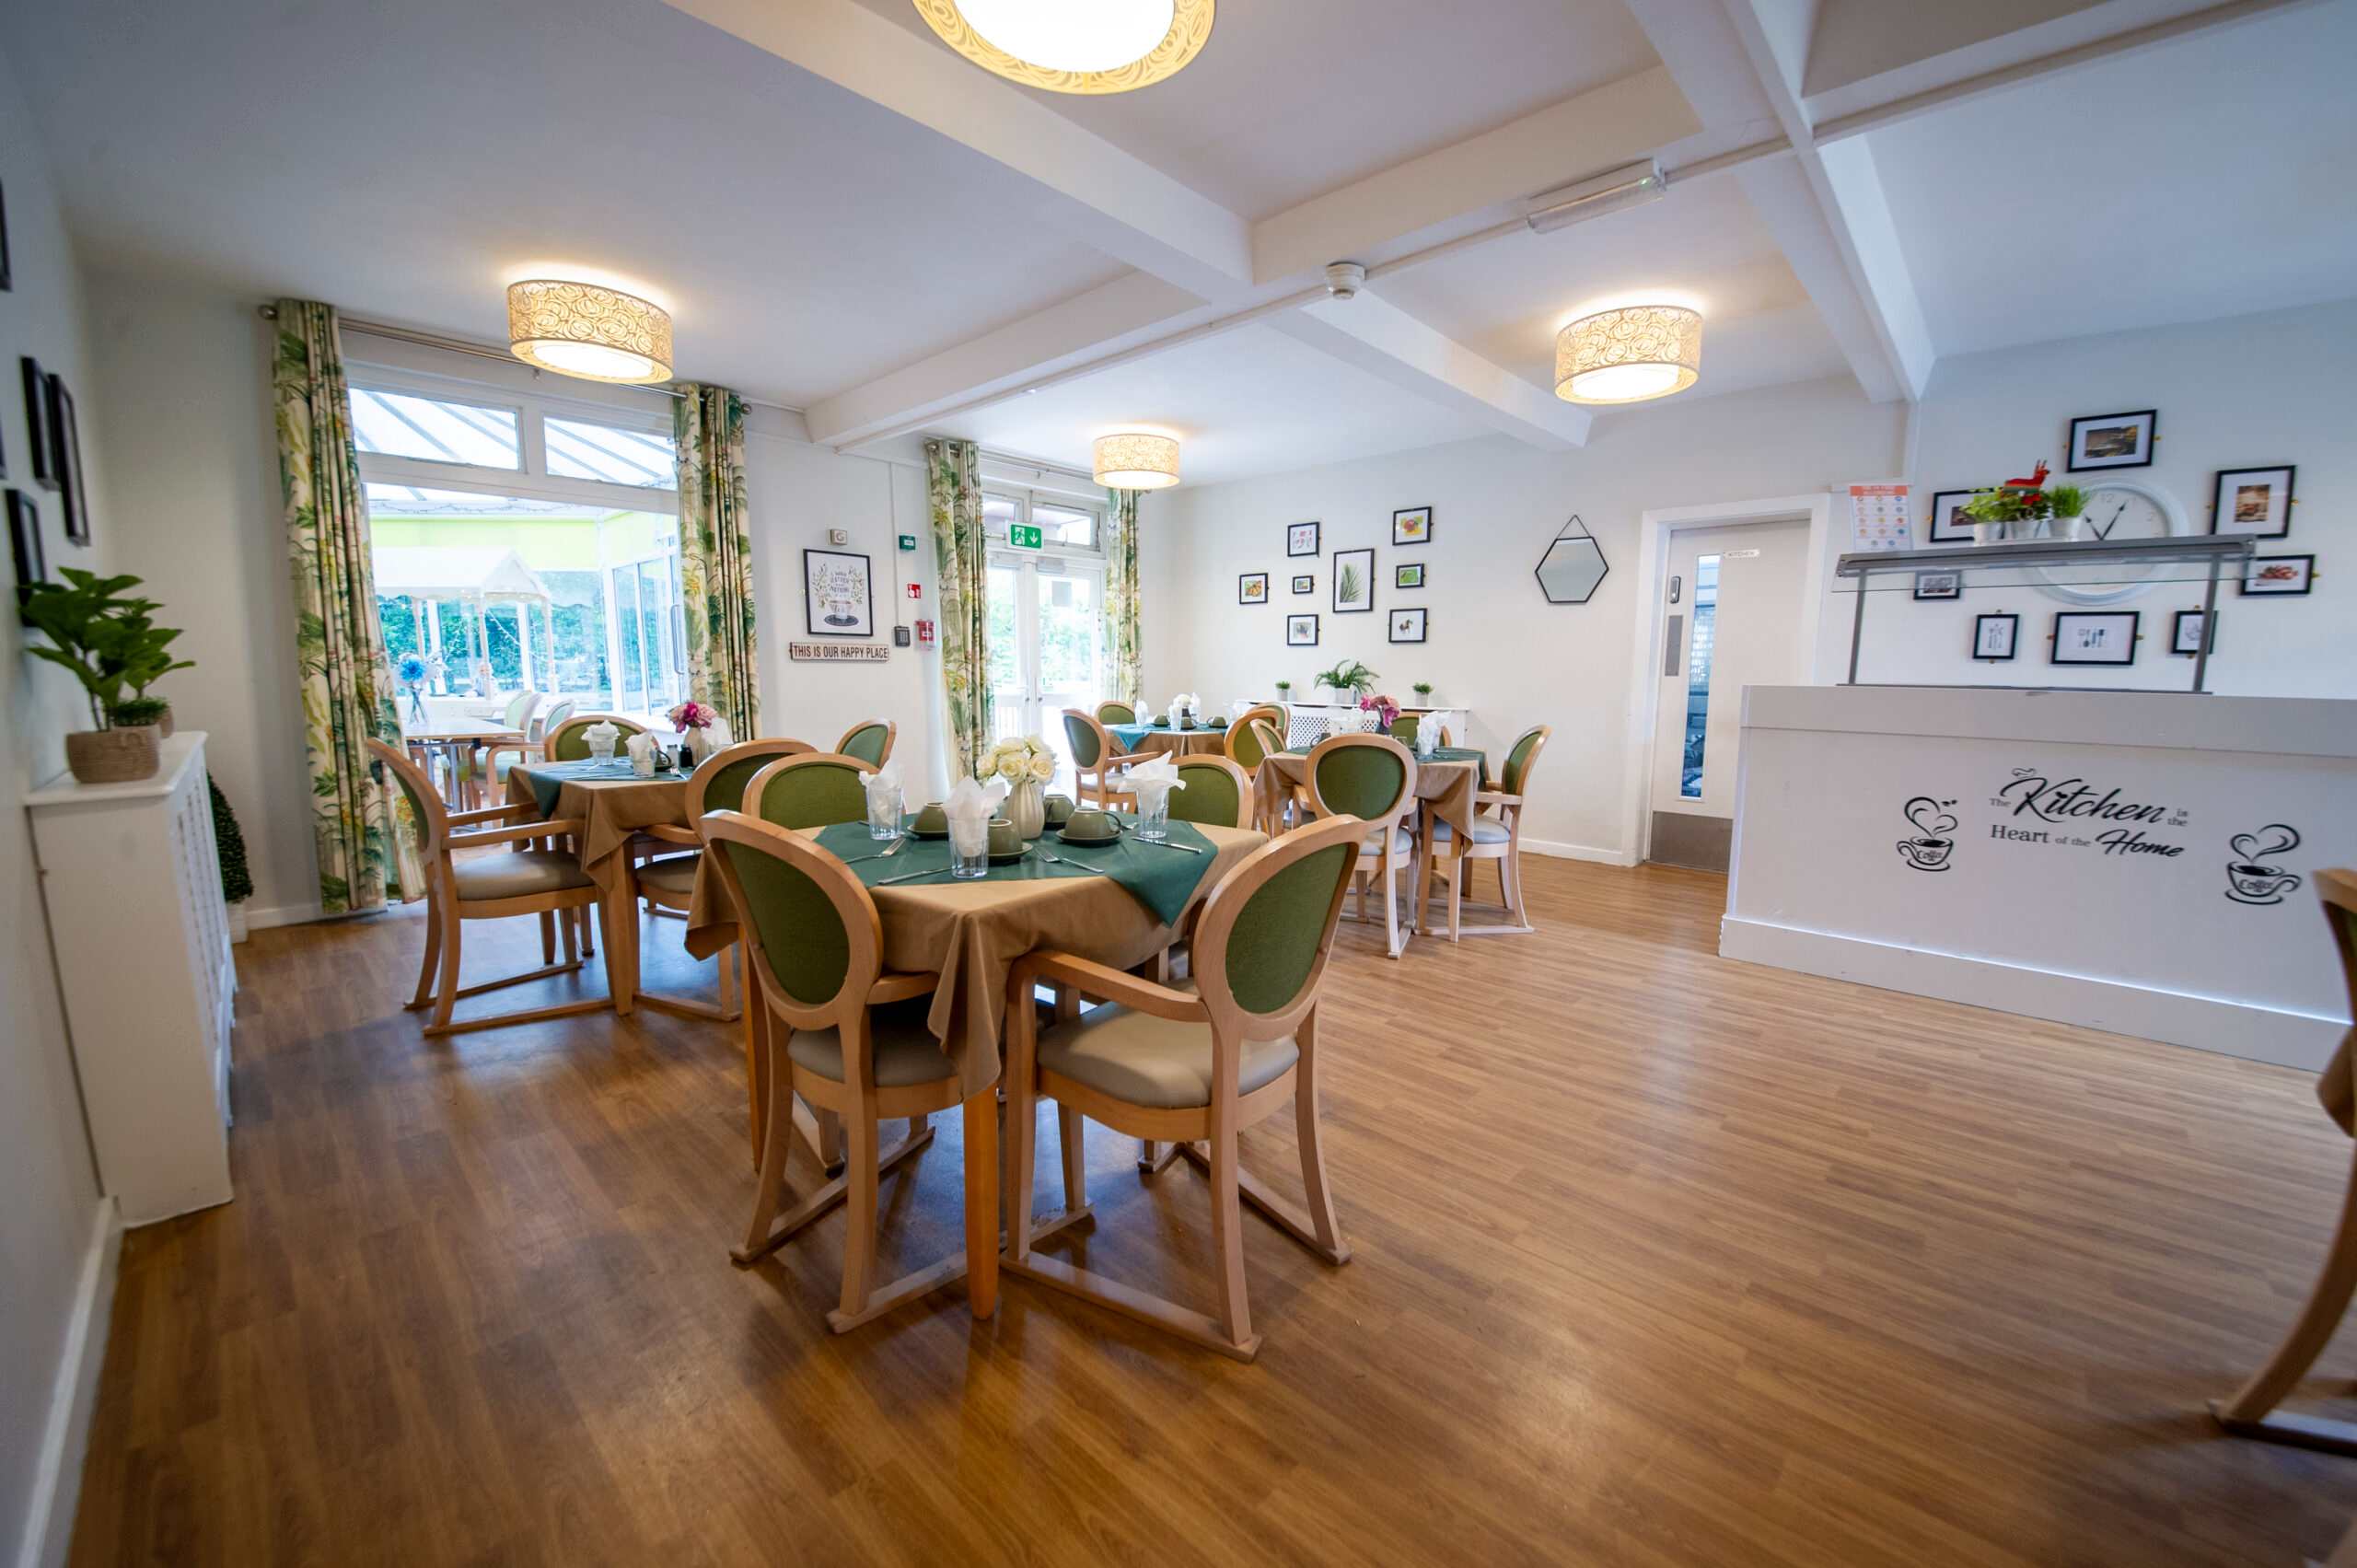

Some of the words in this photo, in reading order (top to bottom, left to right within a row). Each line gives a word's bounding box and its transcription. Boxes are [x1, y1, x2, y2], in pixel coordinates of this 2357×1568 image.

[794, 645, 810, 657] THIS
[813, 645, 821, 657] IS
[823, 646, 838, 657] OUR
[841, 646, 865, 658] HAPPY
[866, 647, 888, 658] PLACE
[1989, 797, 2011, 808] The
[2000, 777, 2166, 823] Kitchen
[2177, 808, 2189, 818] is
[2167, 817, 2188, 827] the
[1991, 824, 2049, 843] Heart
[2055, 836, 2069, 845] of
[2072, 837, 2091, 847] the
[2095, 829, 2185, 857] Home
